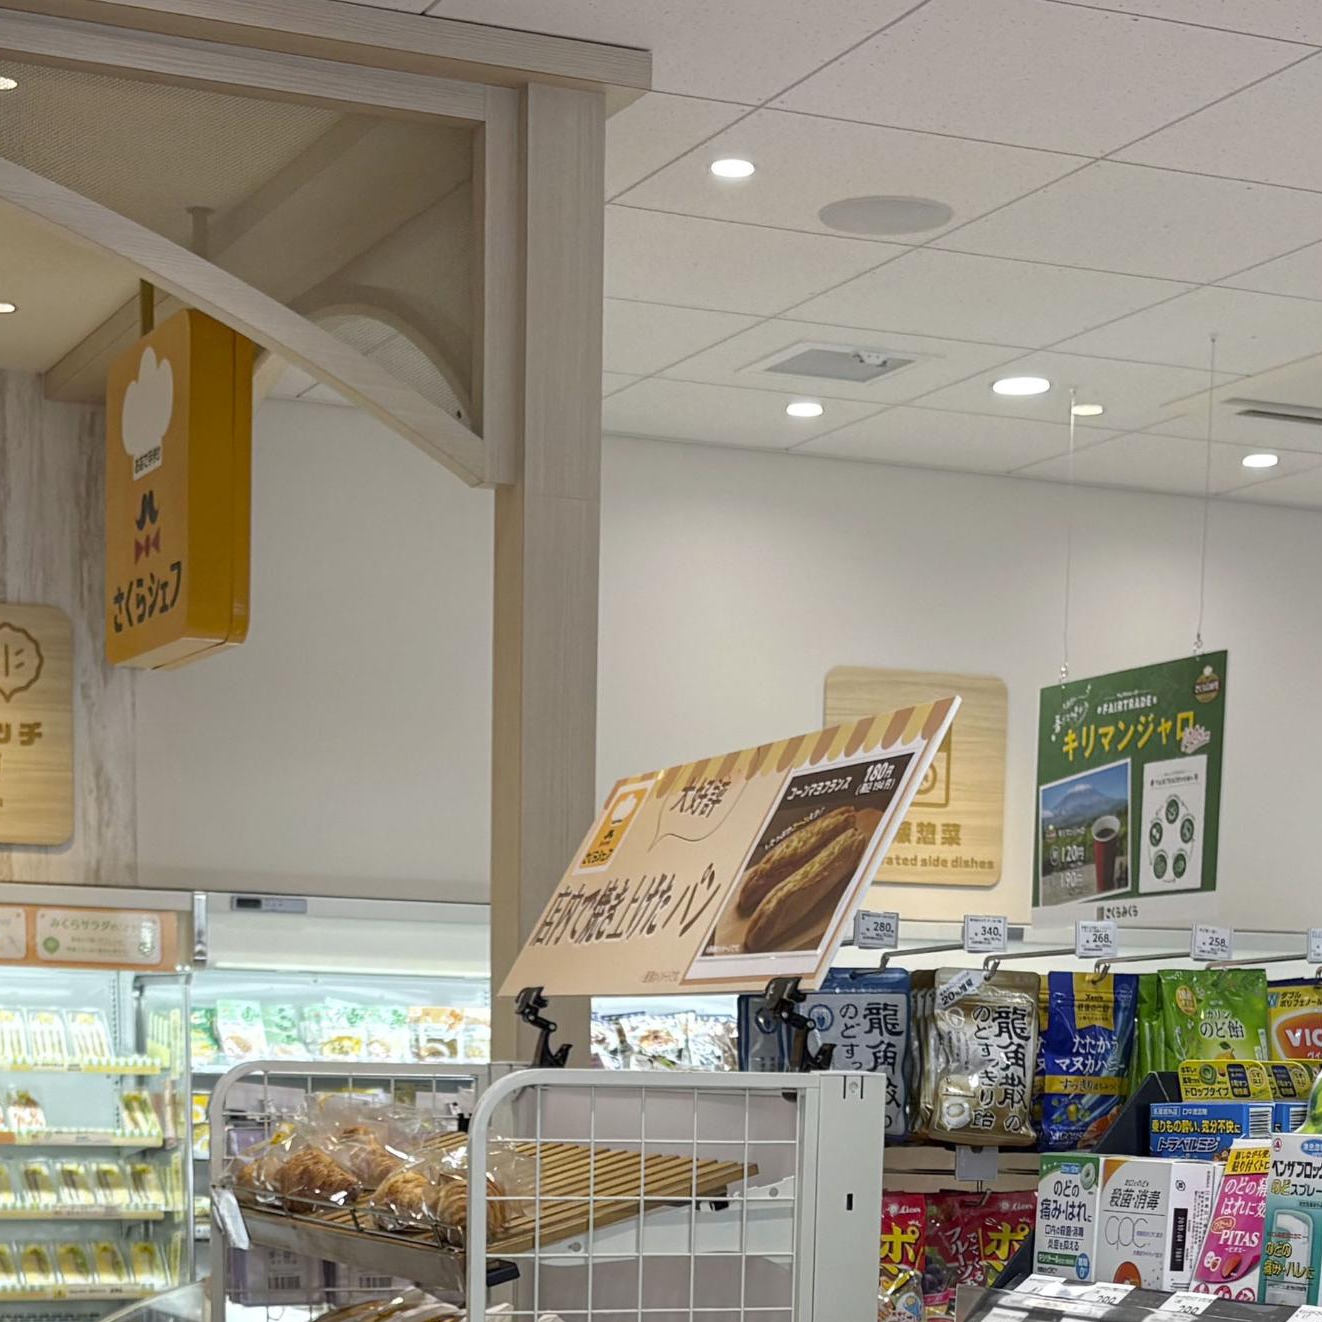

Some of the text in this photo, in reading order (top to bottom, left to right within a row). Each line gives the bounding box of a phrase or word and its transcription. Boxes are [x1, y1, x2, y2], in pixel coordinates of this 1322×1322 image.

[113, 561, 183, 633] さくらシェフ
[1102, 695, 1151, 715] FAIRTRADE
[1062, 711, 1194, 761] キリマンジャロ
[862, 761, 894, 784] 180円
[670, 777, 731, 818] 大好評
[787, 776, 852, 801] コーンマヨフランス
[920, 856, 948, 868] side
[951, 858, 994, 869] dishes
[1199, 1018, 1245, 1039] のど飴
[1072, 1036, 1119, 1054] たたかう
[994, 1005, 1032, 1132] 龍角散の
[1184, 1087, 1229, 1098] ドロップタイプ
[1157, 1137, 1220, 1152] トラベルミン
[1053, 1180, 1080, 1195] のどの
[1271, 1179, 1322, 1196] のどスプレー
[1109, 1188, 1161, 1211] 殺菌・消毒
[1040, 1199, 1092, 1222] 痛み・はれに
[1219, 1230, 1259, 1247] PITAS
[1266, 1242, 1292, 1258] のどの
